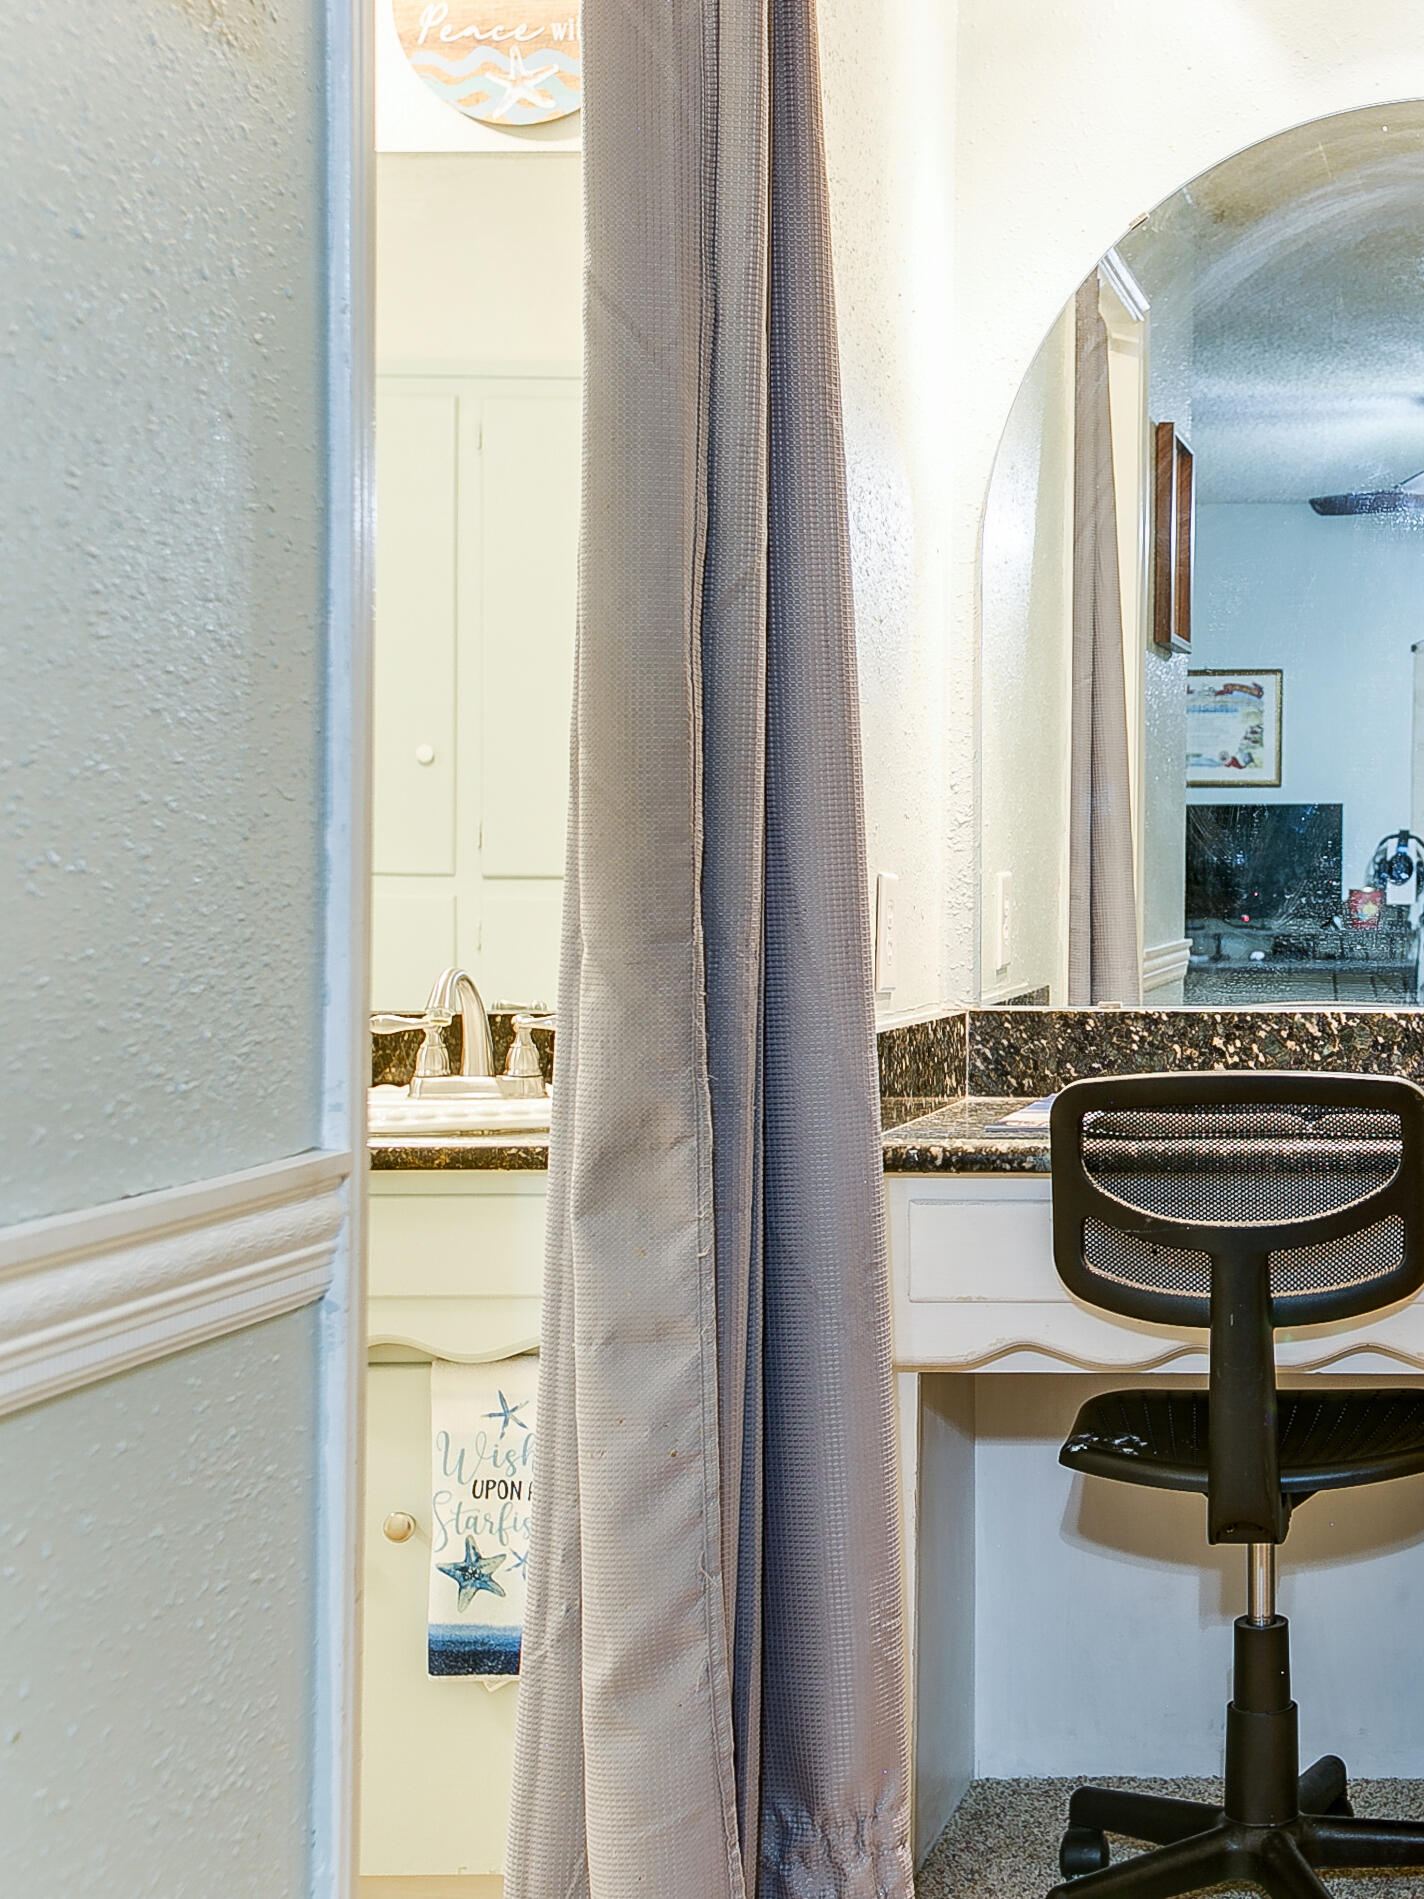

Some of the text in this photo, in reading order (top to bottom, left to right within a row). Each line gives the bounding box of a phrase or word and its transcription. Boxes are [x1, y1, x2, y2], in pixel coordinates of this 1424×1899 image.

[418, 2, 545, 46] Peace
[437, 1430, 536, 1485] Wish
[472, 1479, 522, 1501] UPON
[432, 1490, 531, 1553] Starfis
